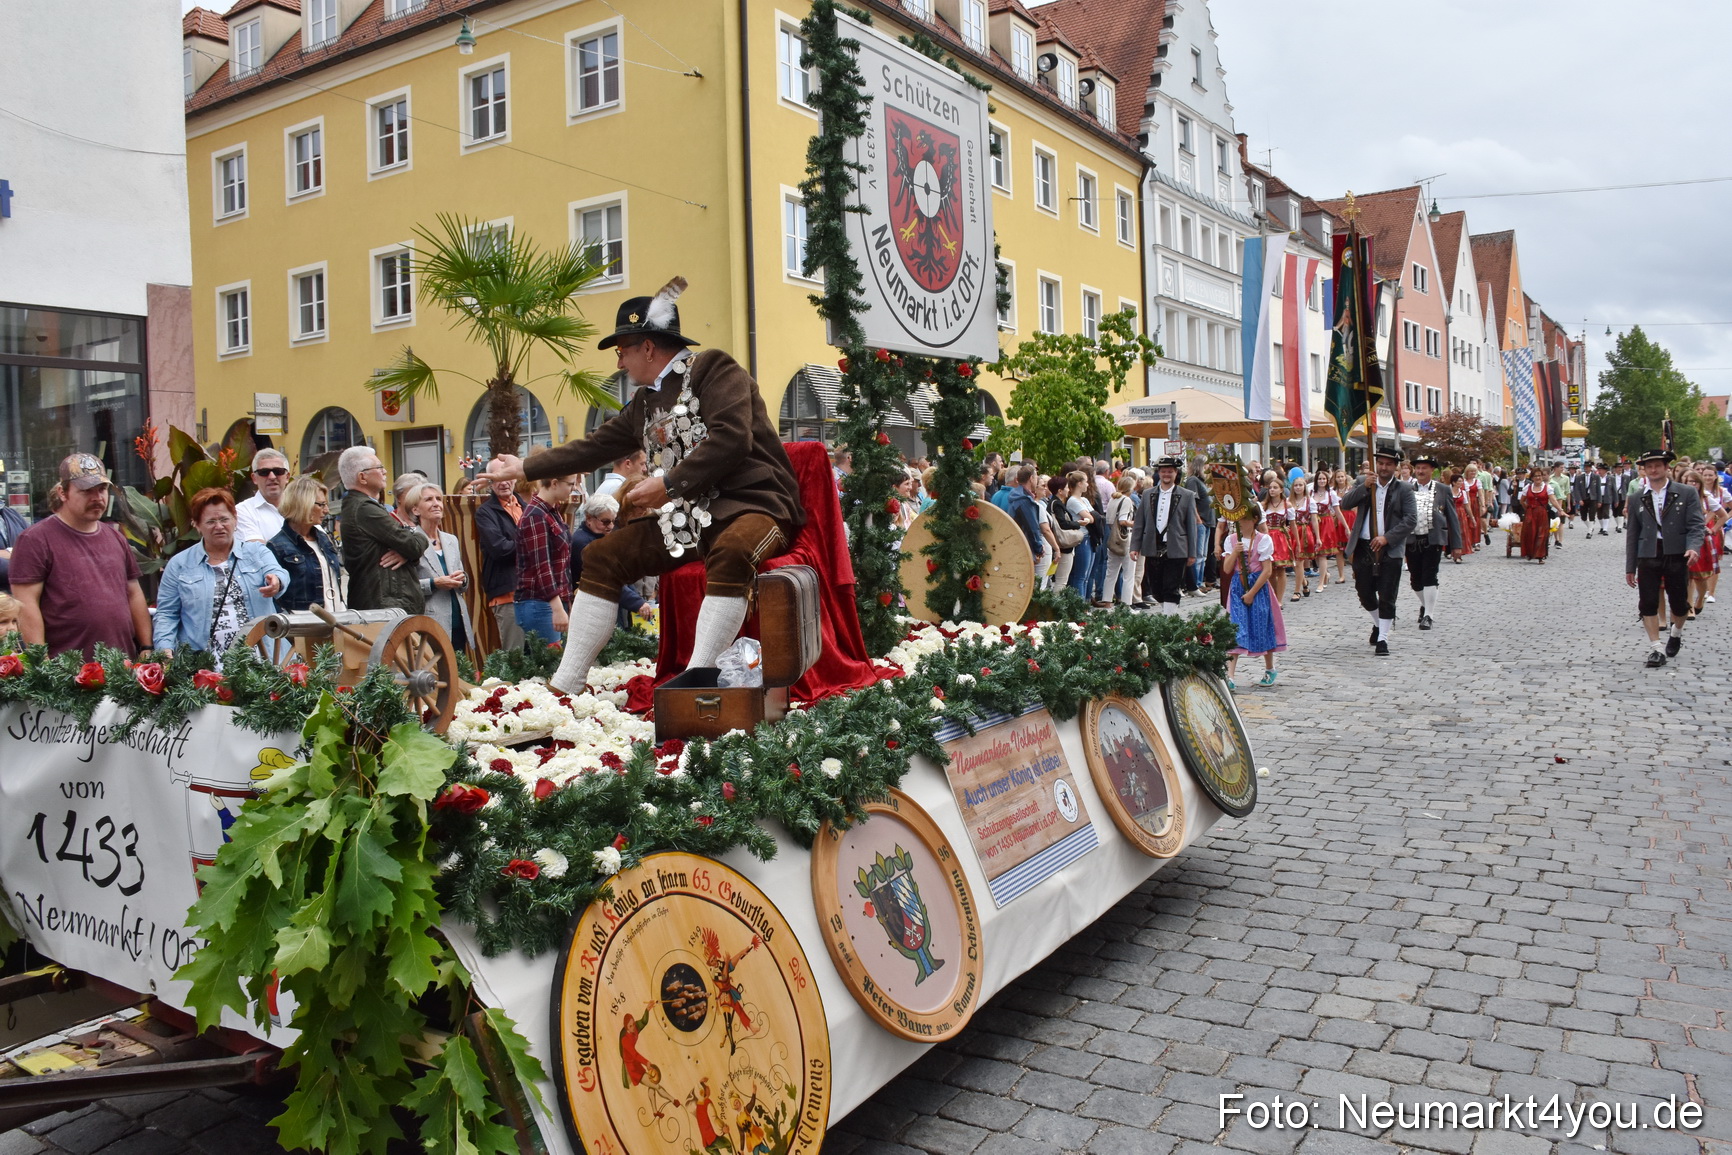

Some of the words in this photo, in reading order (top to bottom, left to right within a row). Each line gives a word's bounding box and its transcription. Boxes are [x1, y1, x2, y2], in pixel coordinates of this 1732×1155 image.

[881, 64, 960, 126] Schützen
[866, 127, 875, 159] 1433
[967, 139, 977, 224] Gesellschaft
[872, 223, 938, 331] Neumarkt
[1131, 406, 1167, 415] Klostergasse
[951, 738, 1013, 775] Neumarkter
[1010, 722, 1052, 752] Volksfest
[59, 779, 105, 799] von
[964, 783, 989, 808] Auch
[987, 775, 1011, 798] unser
[1009, 764, 1035, 785] König
[1032, 759, 1044, 778] ist
[1041, 750, 1062, 773] dabei
[976, 800, 1041, 840] Schützengesellschaft
[985, 845, 999, 859] von
[996, 834, 1014, 852] 1433
[1012, 819, 1042, 845] Neumarkt
[26, 810, 145, 897] 1433
[641, 878, 657, 898] an
[692, 867, 713, 894] 65.
[15, 891, 144, 962] Neumarkt
[688, 925, 702, 948] 1849
[830, 914, 842, 933] 19
[580, 921, 609, 976] Rudi
[577, 976, 593, 1006] von
[610, 991, 626, 1016] 1848
[863, 975, 894, 1017] Peter
[897, 1009, 933, 1036] Bauer
[953, 972, 976, 1017] Konrad
[572, 1009, 596, 1092] Gegeben
